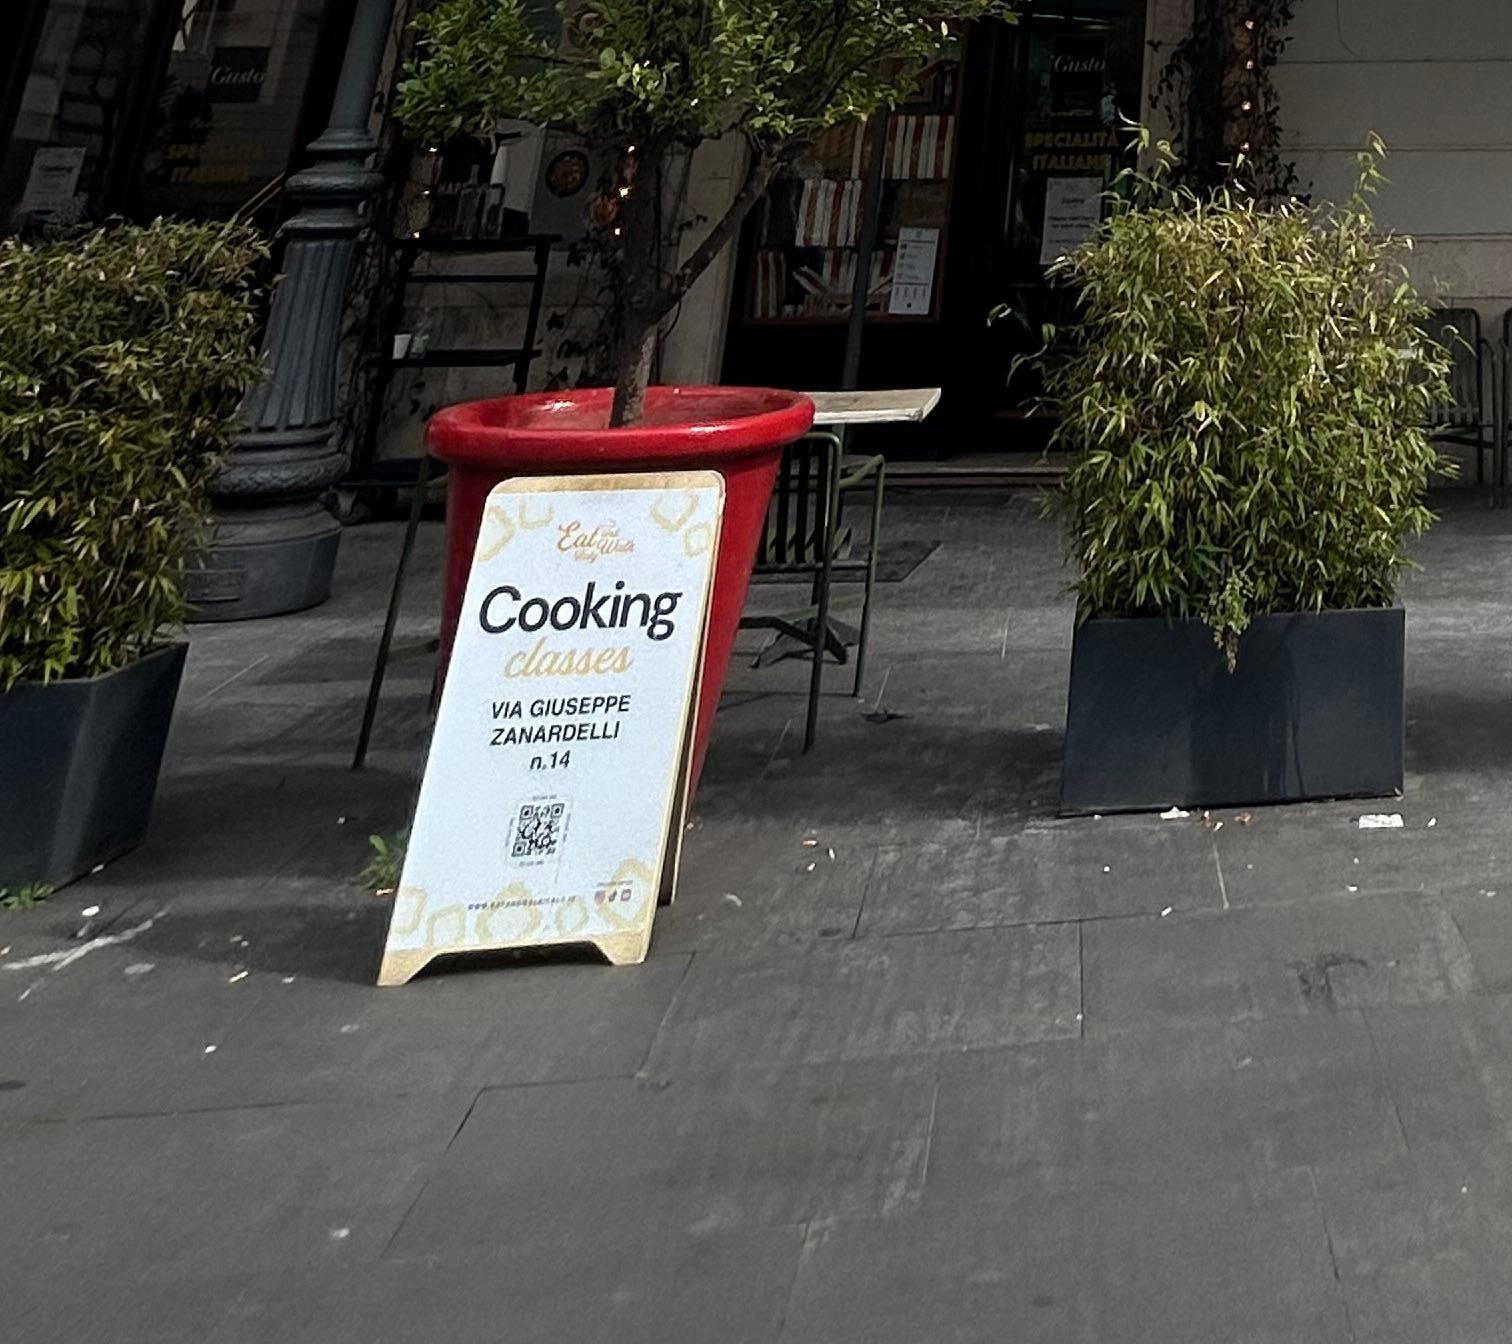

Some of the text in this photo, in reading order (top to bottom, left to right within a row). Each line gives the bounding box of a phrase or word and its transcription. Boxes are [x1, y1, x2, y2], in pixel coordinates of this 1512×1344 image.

[558, 520, 600, 552] Eat
[479, 580, 683, 641] Cooking
[503, 636, 634, 678] classes
[492, 694, 632, 719] VIA GIUSEPPE
[489, 721, 621, 746] ZANARDELLI
[530, 750, 571, 770] n.14
